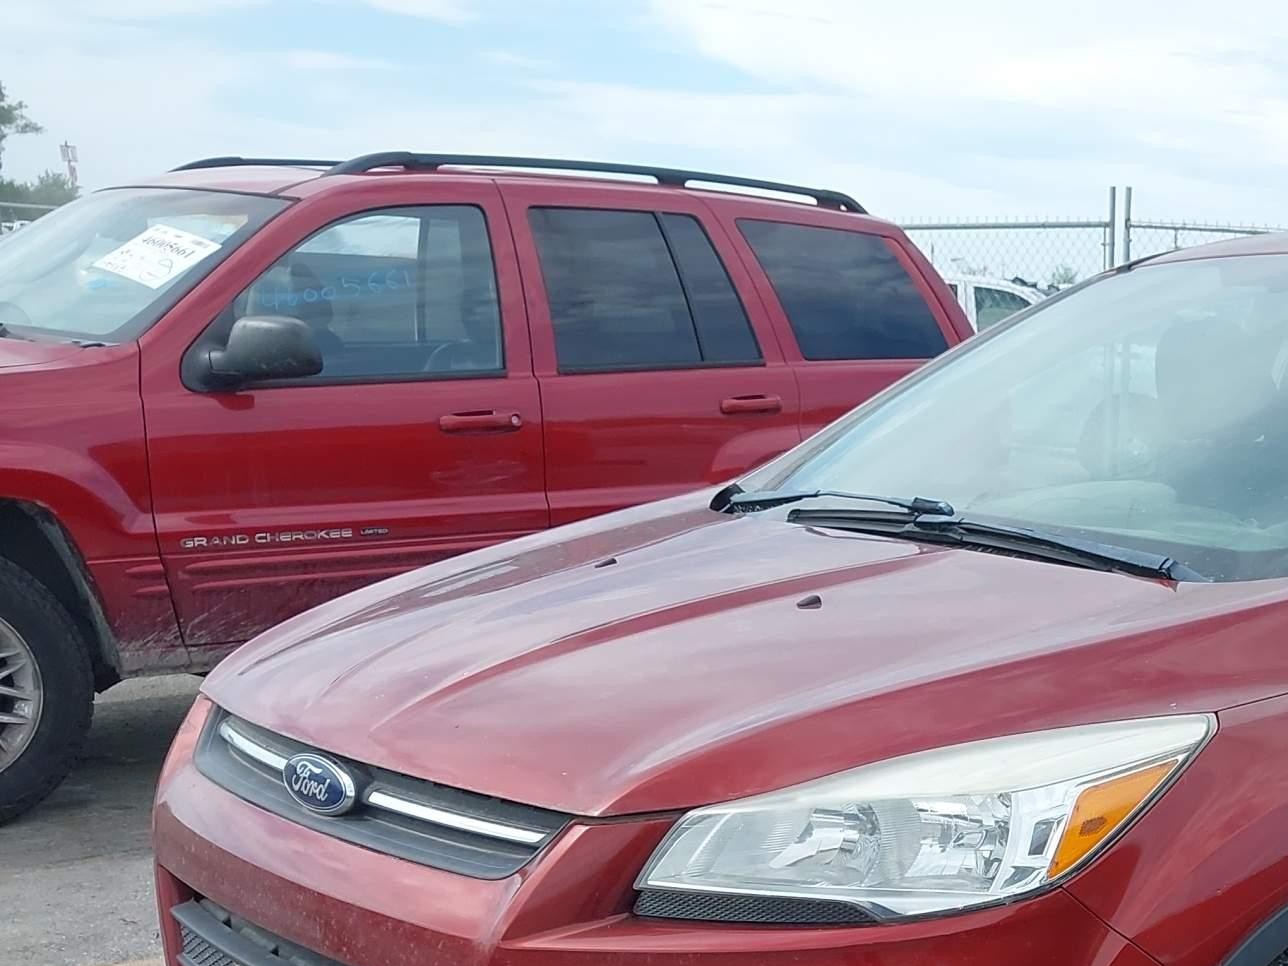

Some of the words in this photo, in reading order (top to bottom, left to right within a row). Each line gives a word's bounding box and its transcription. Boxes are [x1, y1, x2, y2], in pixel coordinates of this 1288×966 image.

[180, 534, 249, 549] GRAND
[254, 528, 353, 543] CHEROKEE
[291, 760, 331, 801] Ford
